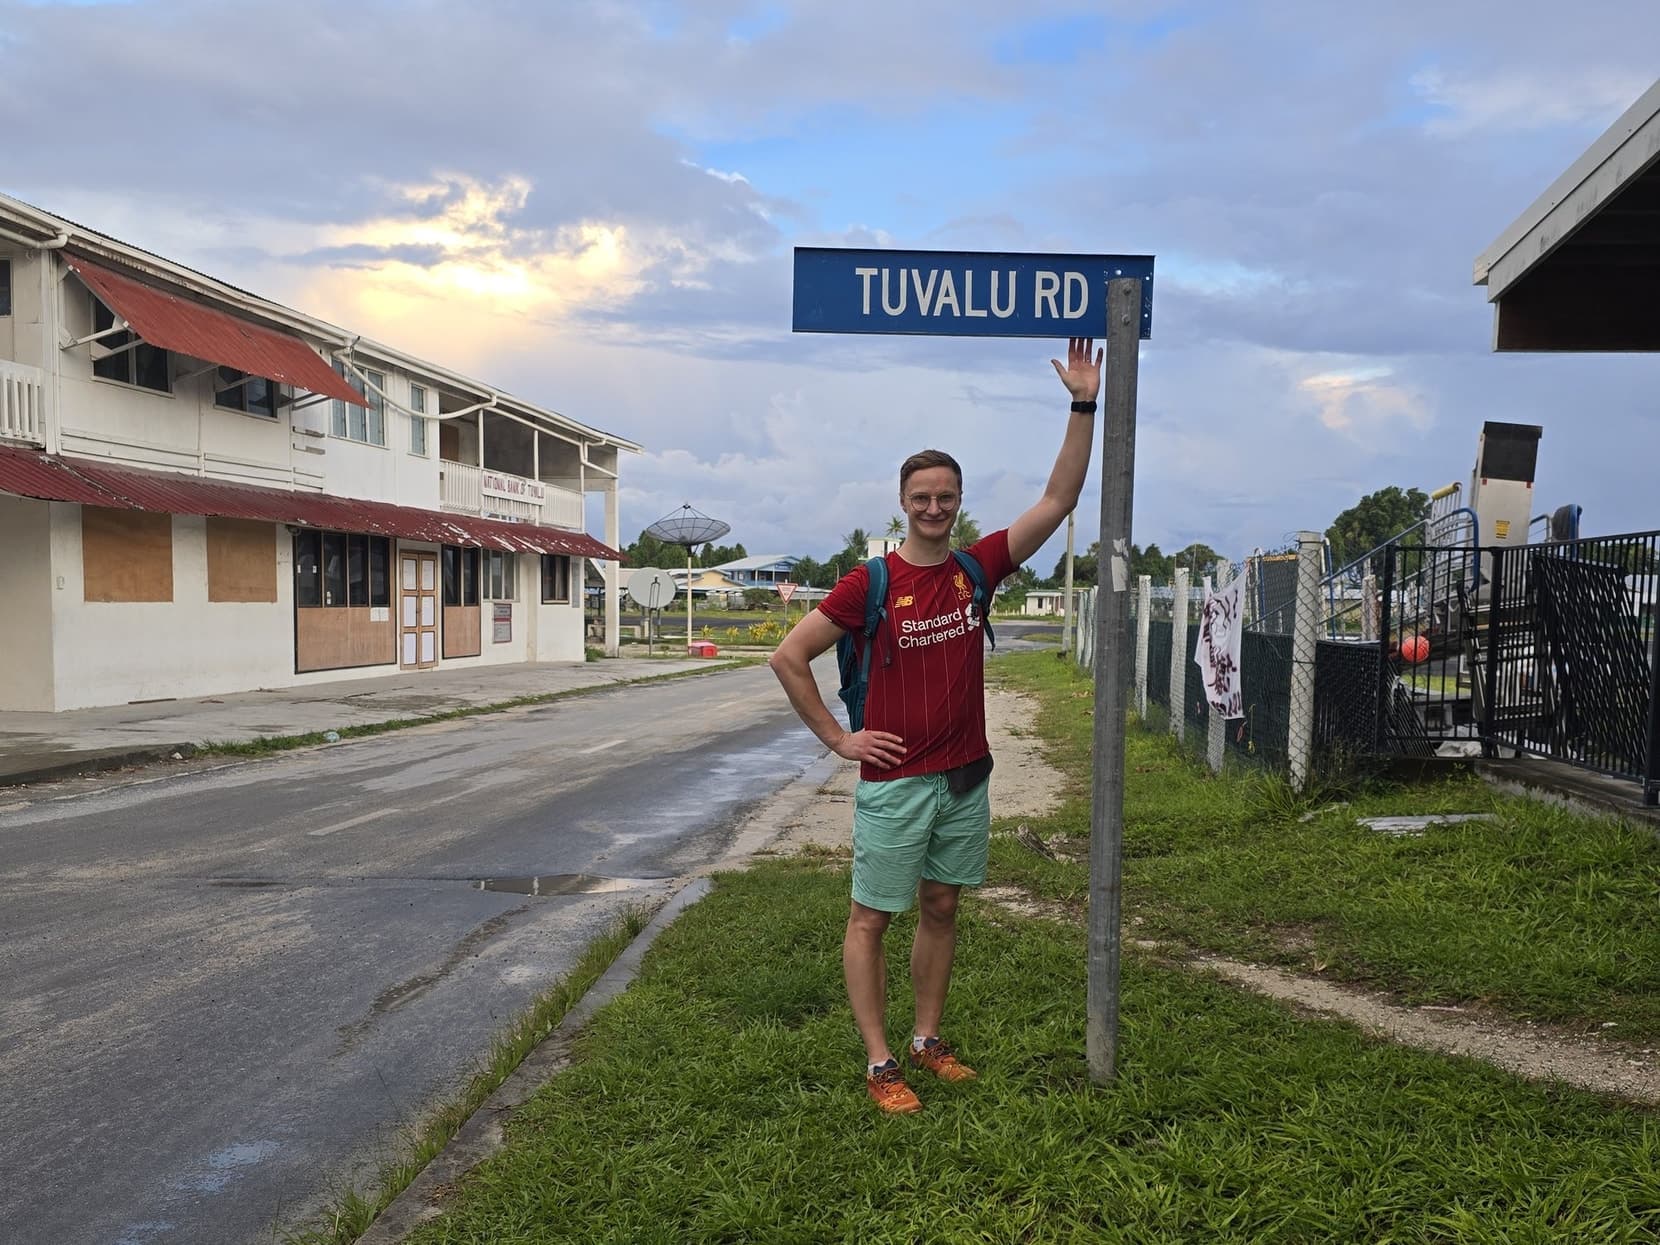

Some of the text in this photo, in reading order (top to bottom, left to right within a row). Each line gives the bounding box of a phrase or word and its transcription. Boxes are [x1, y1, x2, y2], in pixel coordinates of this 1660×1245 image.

[855, 267, 1090, 319] TUVALU RD
[957, 590, 972, 600] LFC
[901, 608, 963, 633] Standard
[898, 623, 966, 649] Chartered
